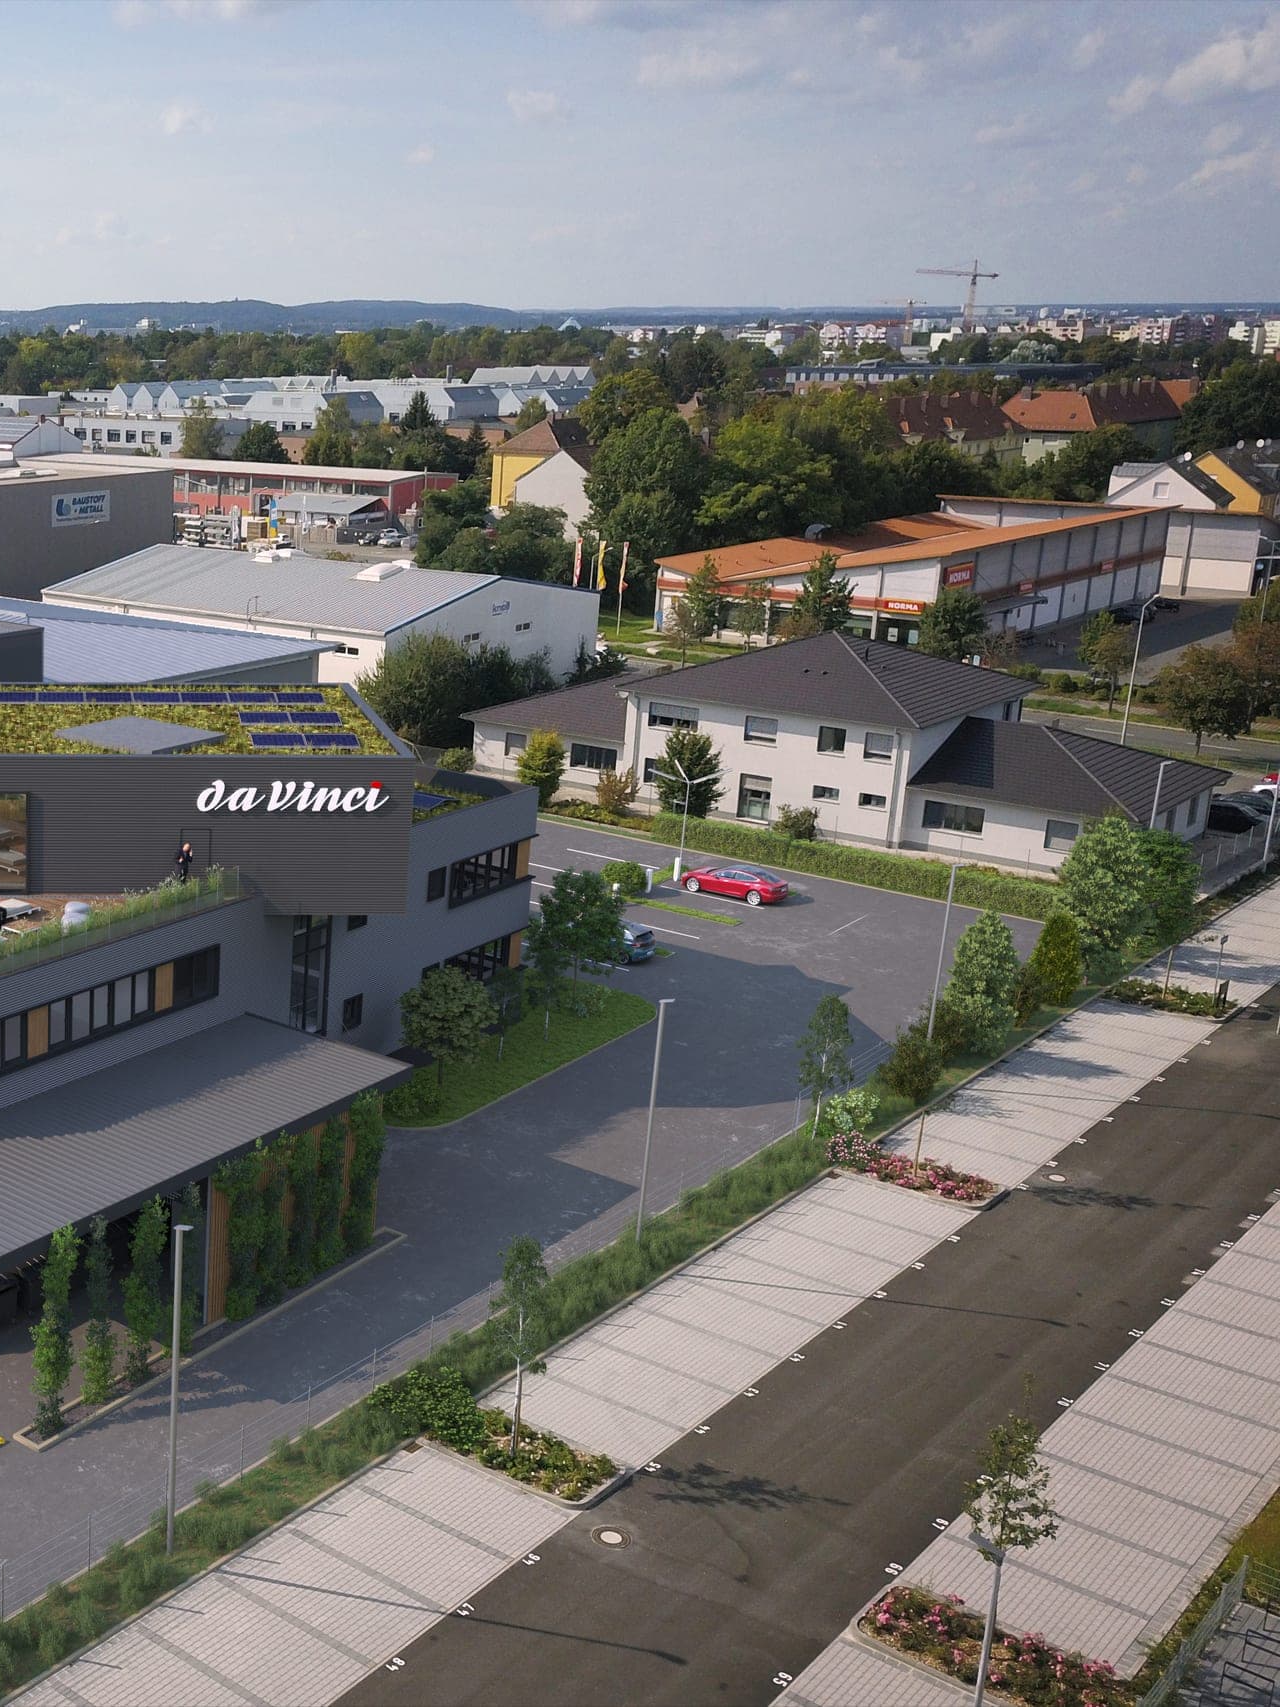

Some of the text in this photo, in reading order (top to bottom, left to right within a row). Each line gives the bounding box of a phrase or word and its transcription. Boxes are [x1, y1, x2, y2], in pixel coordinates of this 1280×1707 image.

[949, 569, 971, 584] NORMA
[888, 602, 919, 611] NORMA
[789, 1353, 805, 1362] 42
[743, 1387, 760, 1397] 43
[694, 1425, 711, 1434] 44
[644, 1461, 662, 1472] 45
[932, 1518, 949, 1530] 67
[522, 1553, 541, 1566] 46
[884, 1562, 904, 1576] 66
[456, 1602, 475, 1616] 47
[385, 1657, 406, 1672] 48
[772, 1671, 793, 1687] 65
